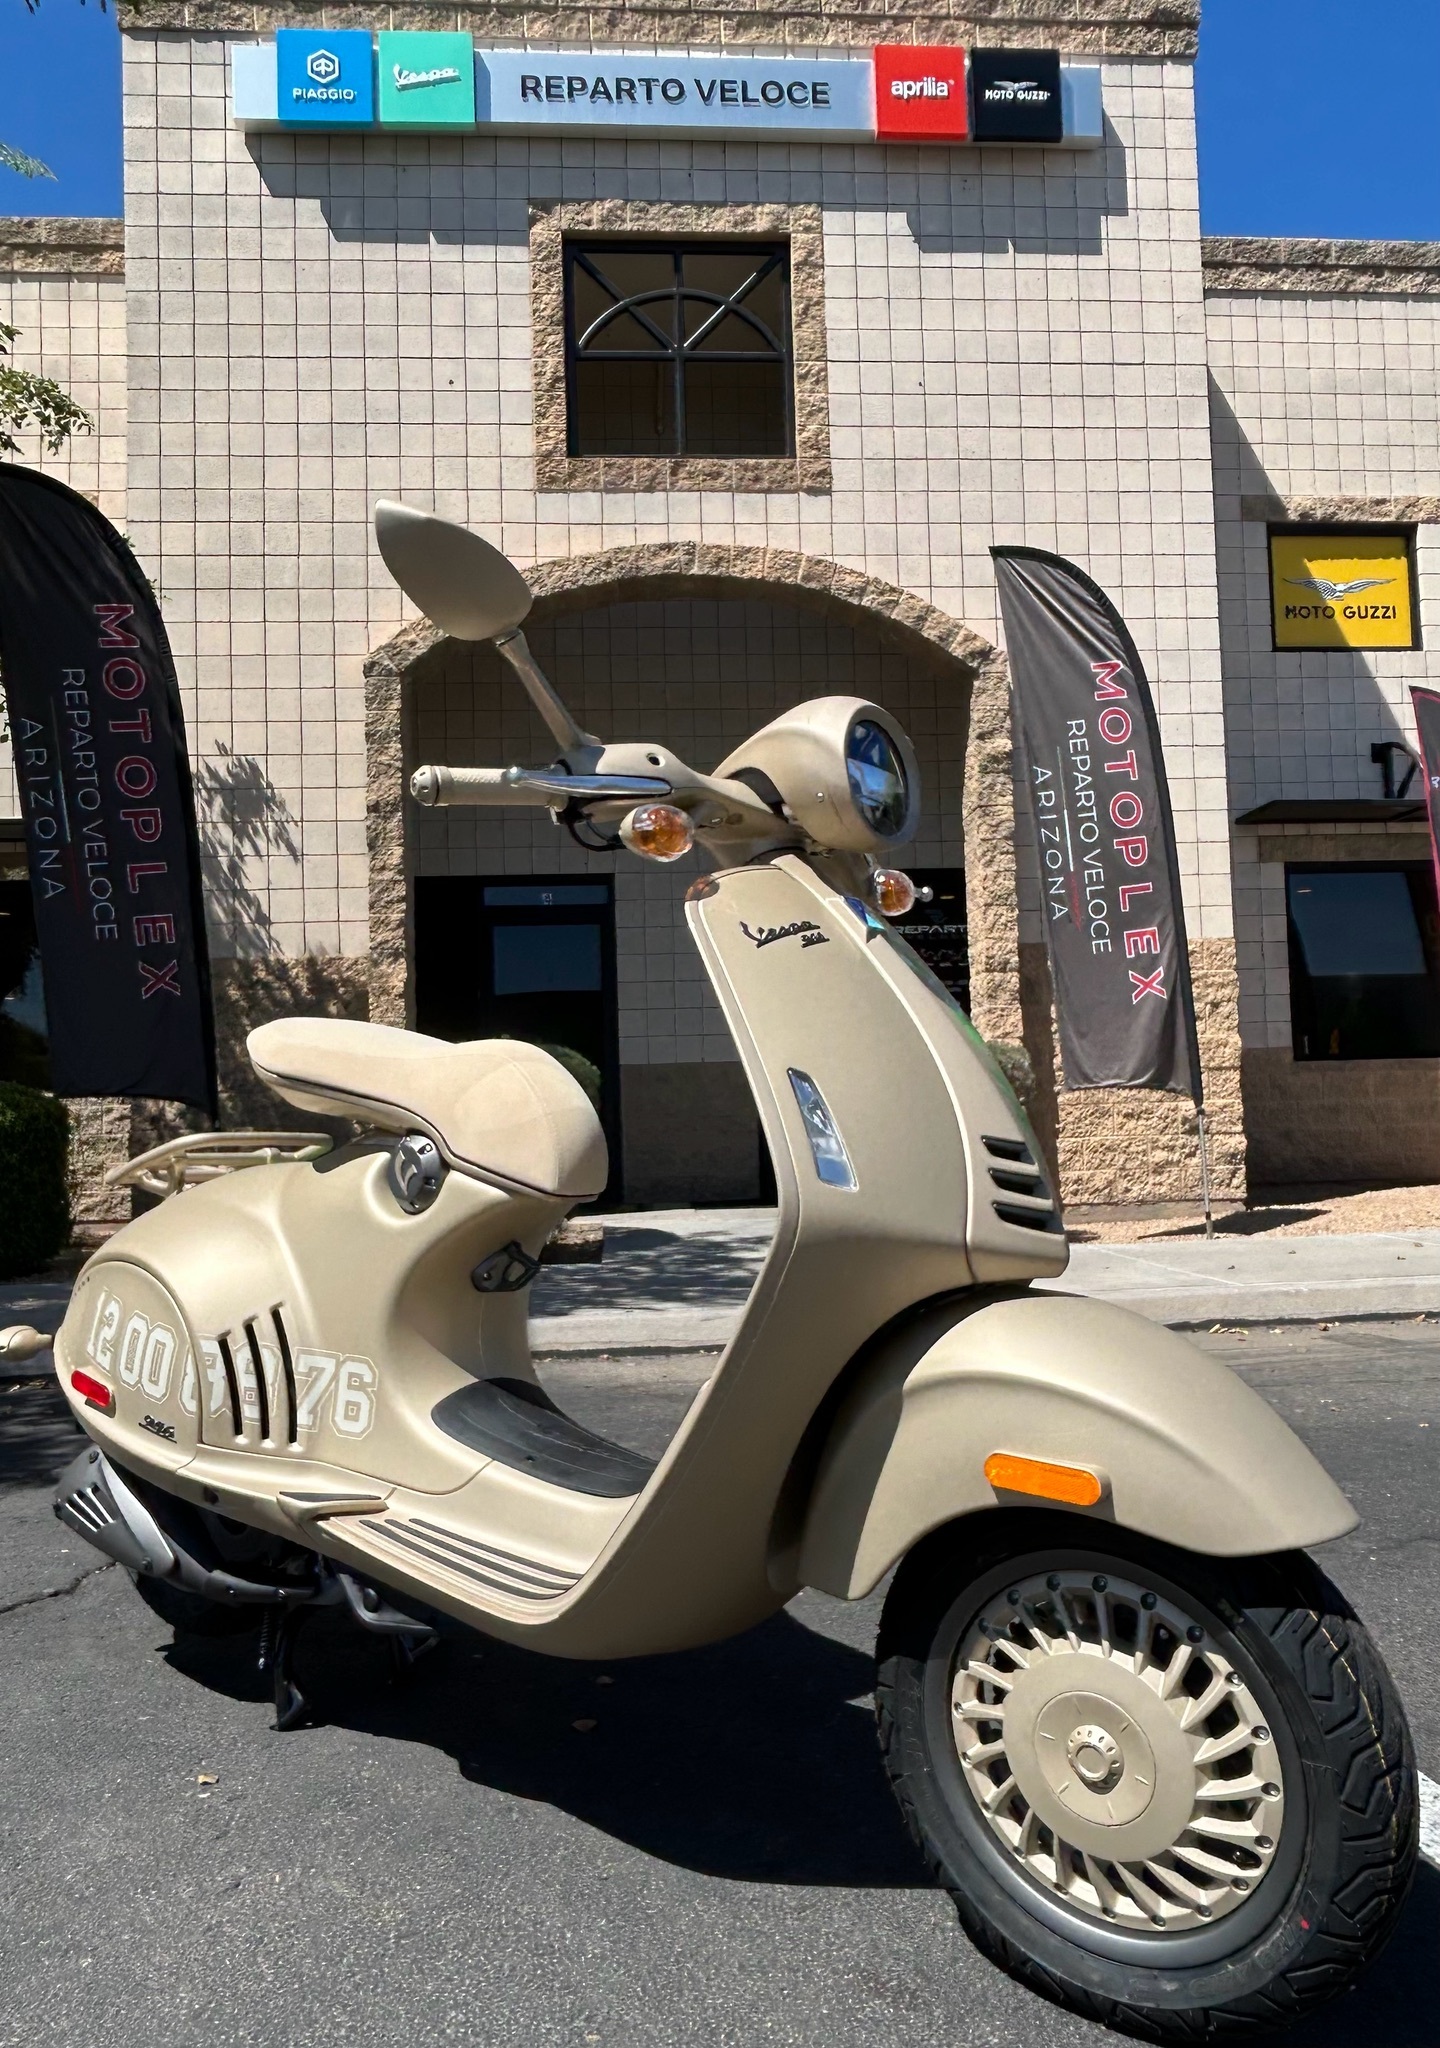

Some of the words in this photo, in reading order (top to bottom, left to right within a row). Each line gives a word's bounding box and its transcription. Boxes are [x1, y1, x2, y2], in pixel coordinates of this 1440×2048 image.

[292, 87, 355, 101] PIAGGIO
[393, 63, 460, 89] Vespa
[521, 74, 687, 104] REPARTO
[694, 78, 831, 106] VELOCE
[891, 76, 949, 99] aprilia
[985, 89, 1014, 100] MOTO
[1017, 90, 1049, 101] GUZZI
[1284, 605, 1336, 619] MOTO
[1342, 605, 1397, 619] GUZZI
[20, 717, 66, 900] ARIZONA
[61, 667, 101, 811] REPARTO
[82, 819, 118, 941] VELOCE
[93, 603, 181, 1000] MOTOPLEX
[1066, 719, 1099, 843] REPARTO
[1032, 765, 1069, 920] ARIZONA
[1090, 659, 1167, 1005] MOTOPLEX
[739, 920, 821, 949] Vespa
[1082, 848, 1112, 955] VELOCE
